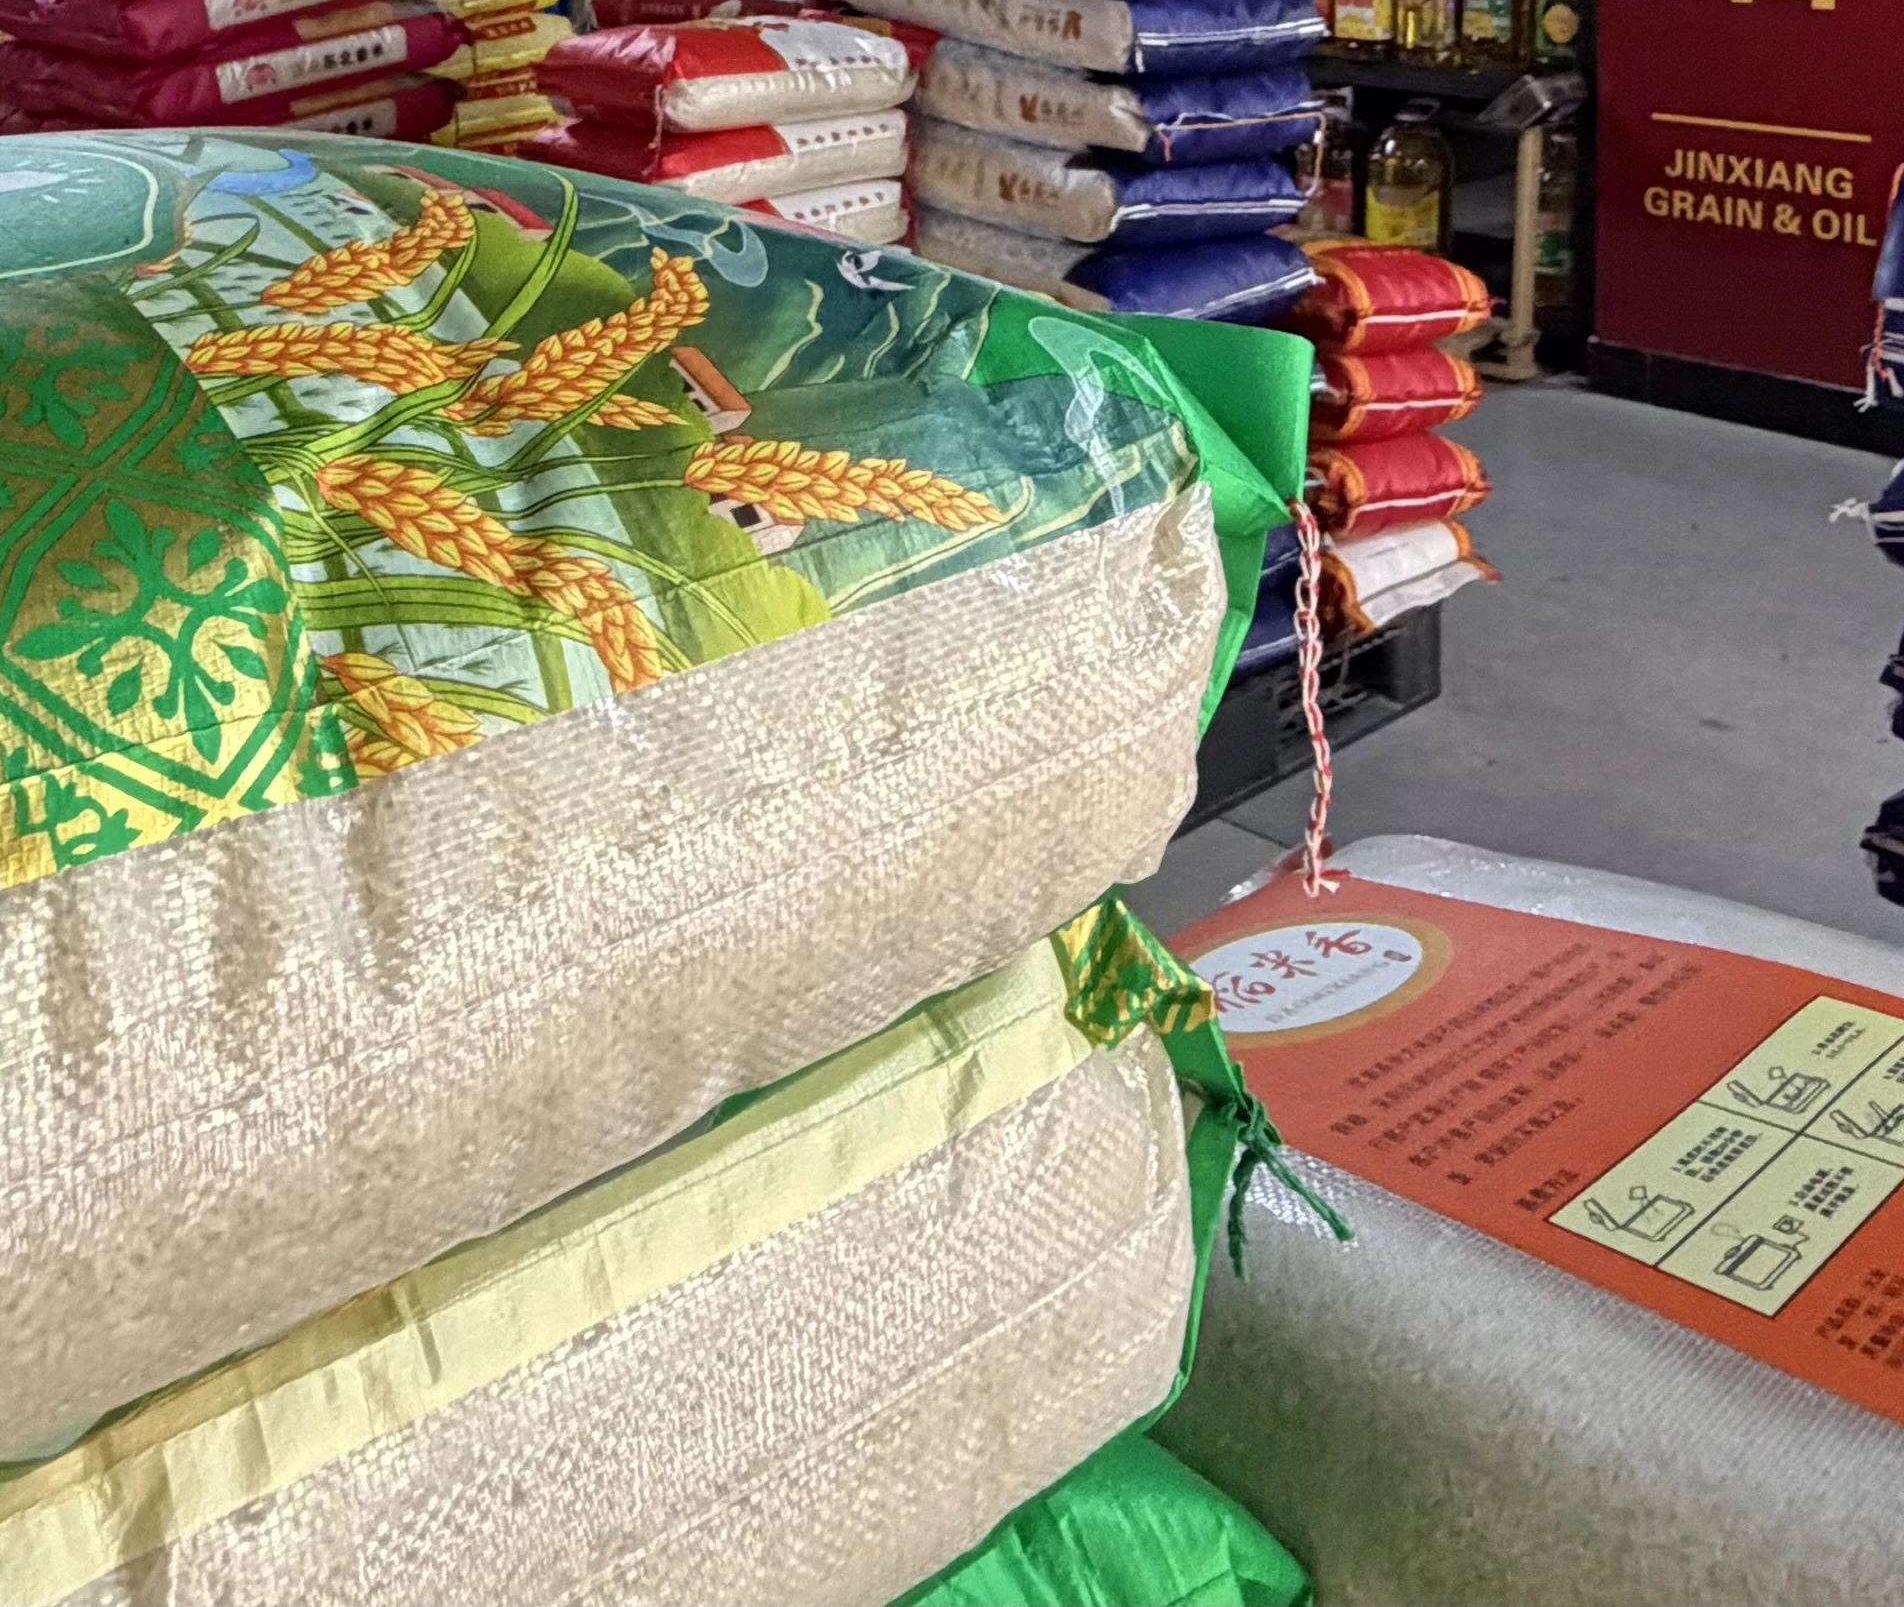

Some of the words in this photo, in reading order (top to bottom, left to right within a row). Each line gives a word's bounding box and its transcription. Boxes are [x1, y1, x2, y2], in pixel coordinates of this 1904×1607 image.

[322, 41, 386, 71] 东北香米
[1664, 149, 1854, 199] JINXIANG
[1644, 186, 1763, 230] GRAIN
[1773, 204, 1802, 236] &
[1812, 209, 1878, 247] OIL
